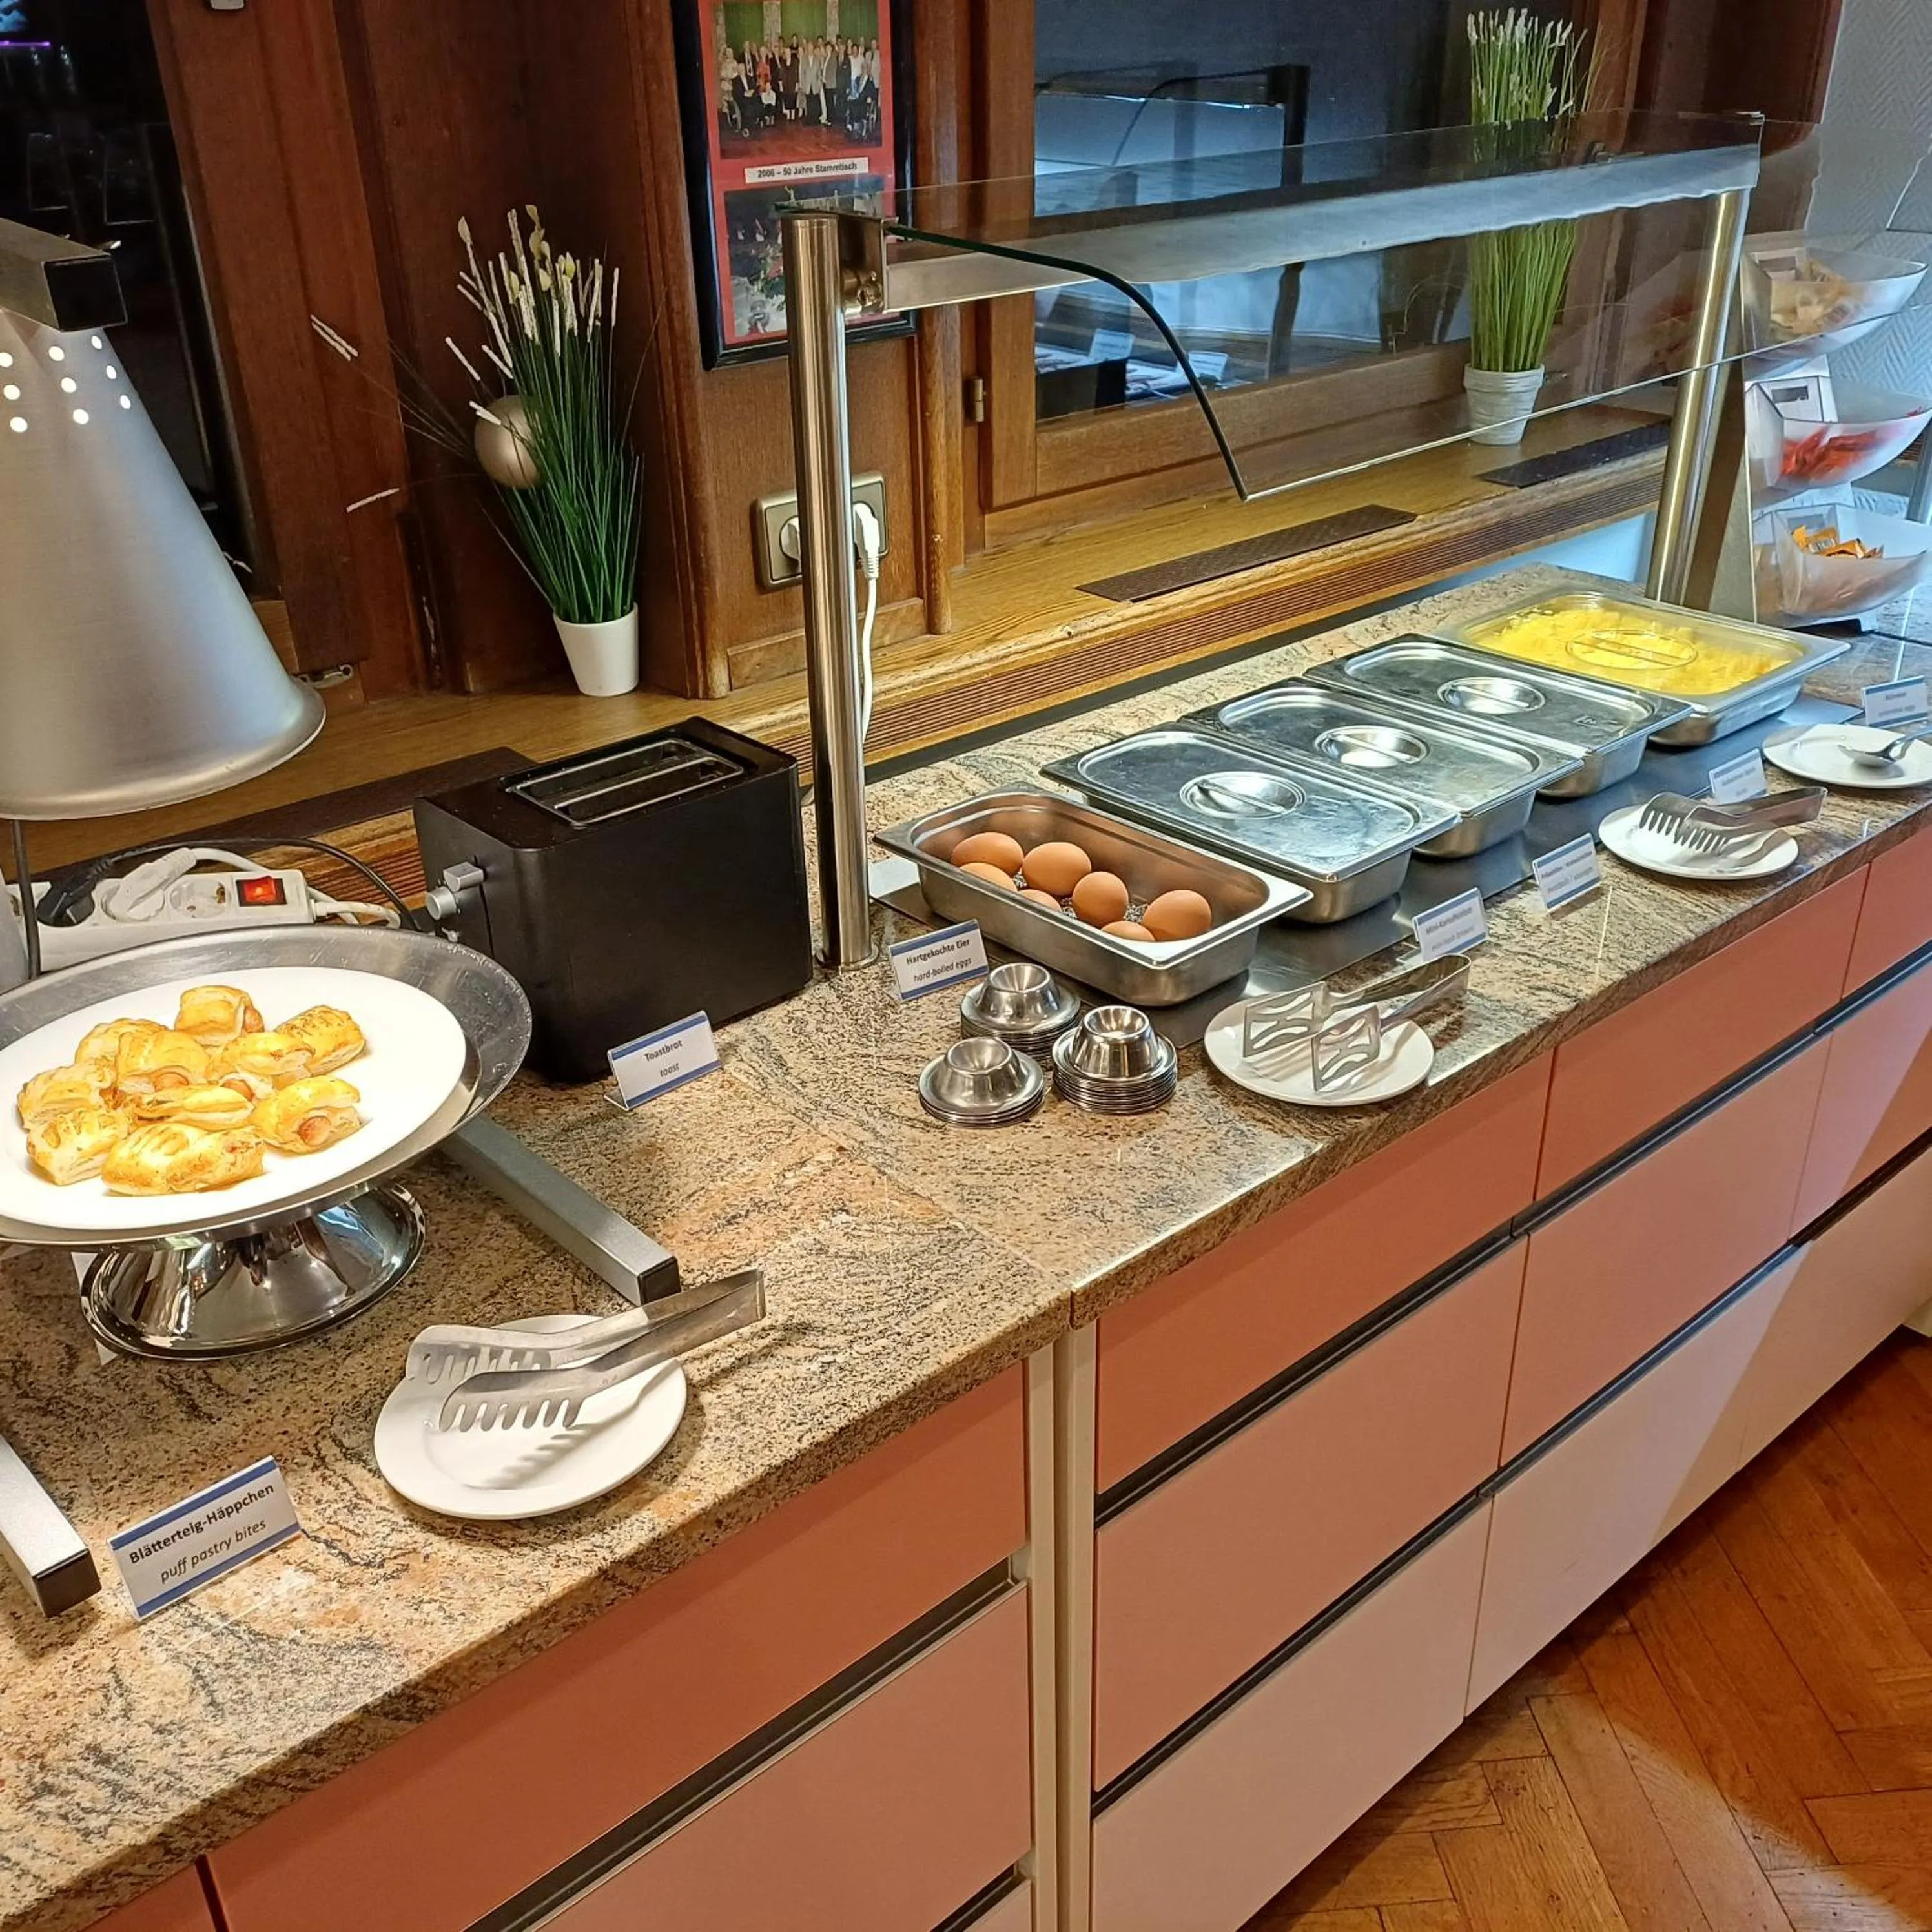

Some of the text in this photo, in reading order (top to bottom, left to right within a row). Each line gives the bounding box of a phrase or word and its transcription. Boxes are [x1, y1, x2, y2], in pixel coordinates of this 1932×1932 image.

[783, 167, 792, 176] 50
[793, 165, 814, 175] Jahre
[815, 161, 858, 173] Stammtisch
[906, 939, 970, 965] Hartgekochte Eier
[914, 958, 972, 982] hard-boiled eggs
[644, 1040, 683, 1062] Toastbrot
[660, 1062, 679, 1077] toast
[129, 1483, 274, 1565] Blätterteig-Häppchen
[160, 1519, 267, 1584] puff pastry bites
